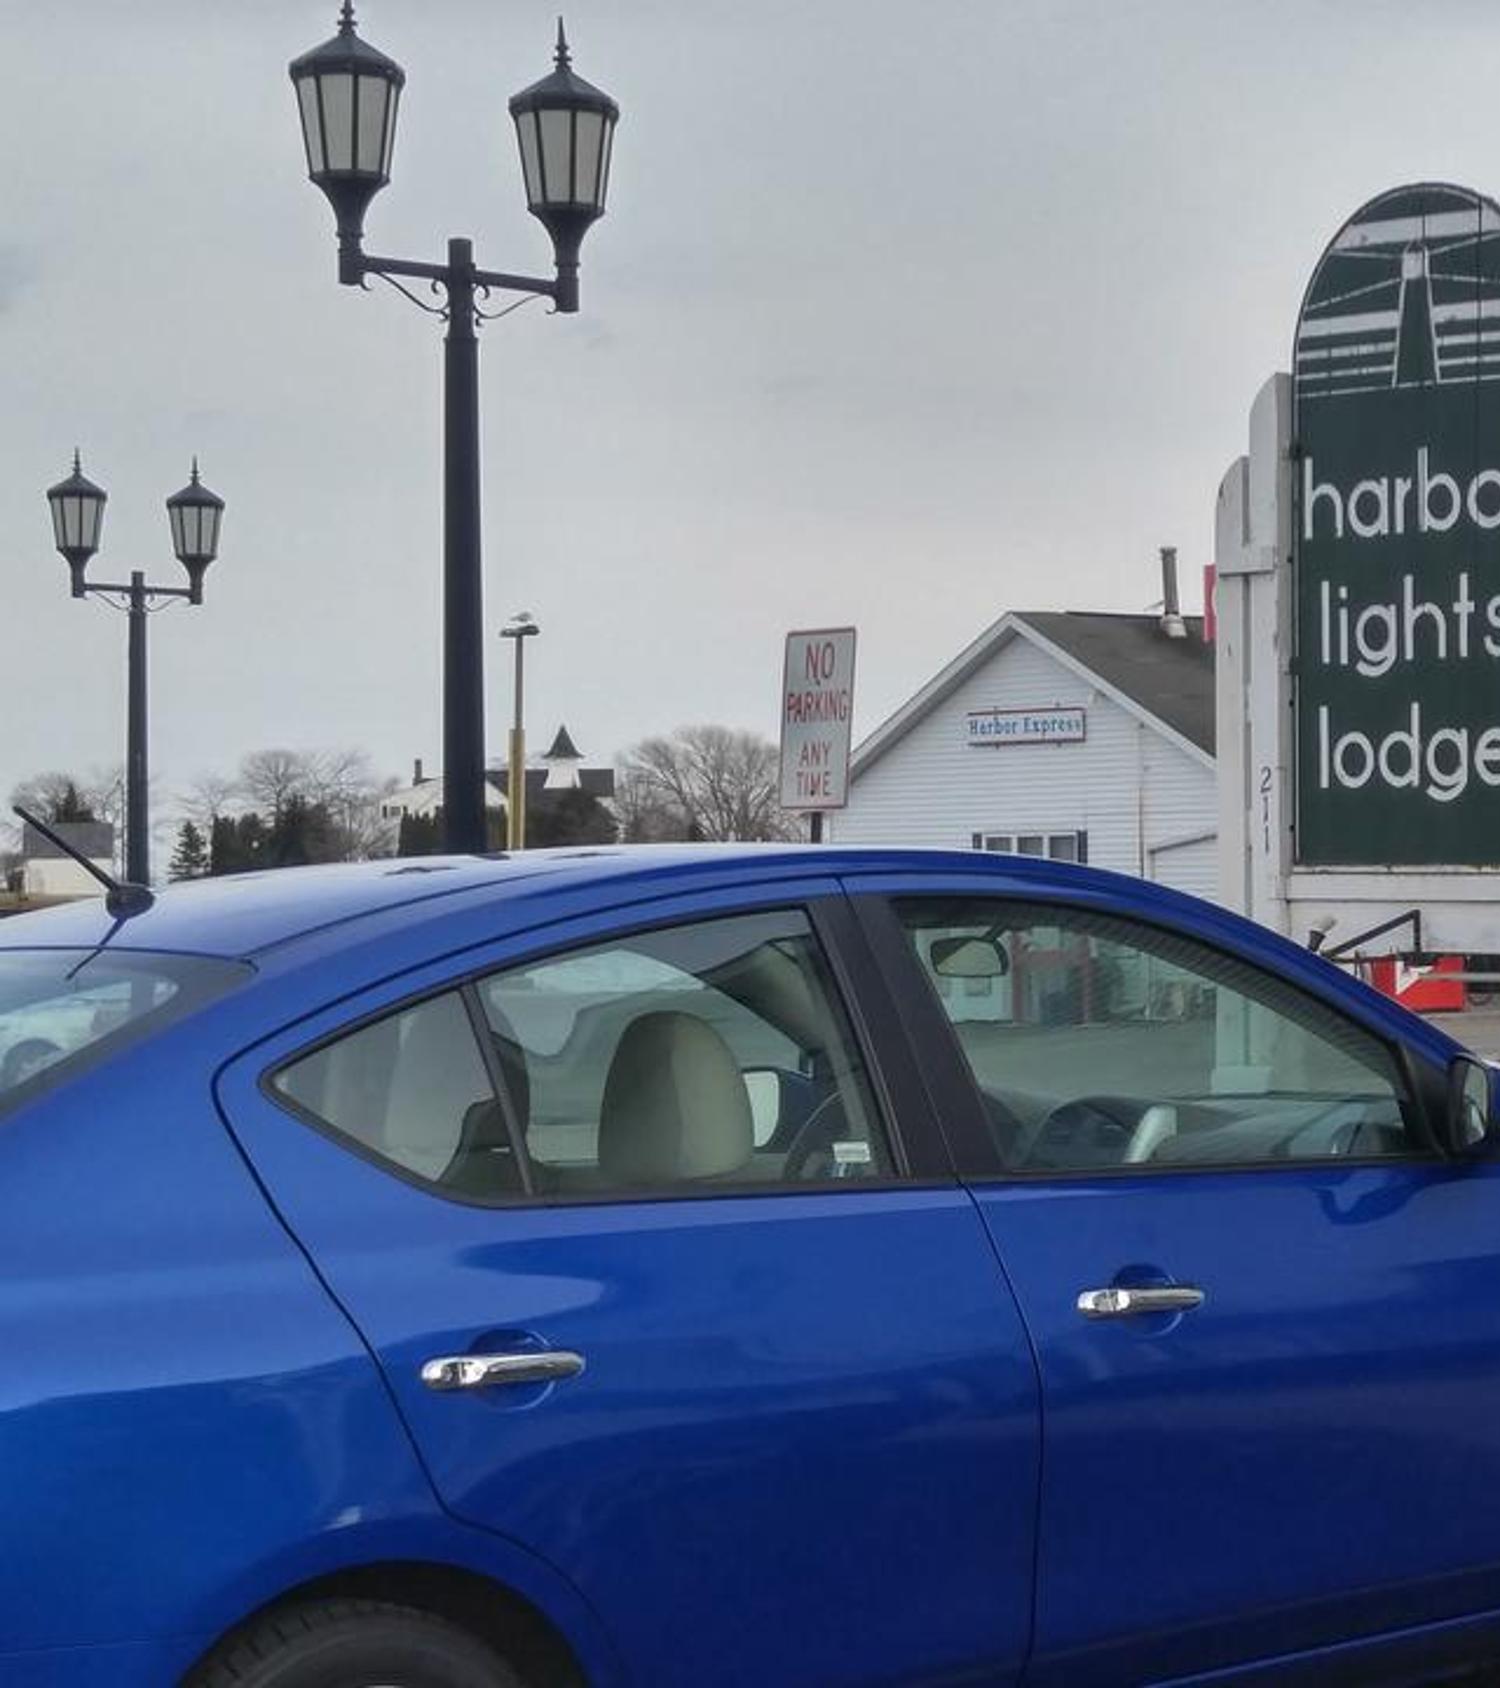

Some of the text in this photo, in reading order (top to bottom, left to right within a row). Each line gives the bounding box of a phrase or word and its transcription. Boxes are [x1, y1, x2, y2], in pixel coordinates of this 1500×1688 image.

[806, 642, 836, 680] NO
[787, 690, 849, 724] PARKING
[969, 716, 1081, 736] Harbor Express
[801, 740, 832, 767] ANY
[796, 770, 831, 797] TIME
